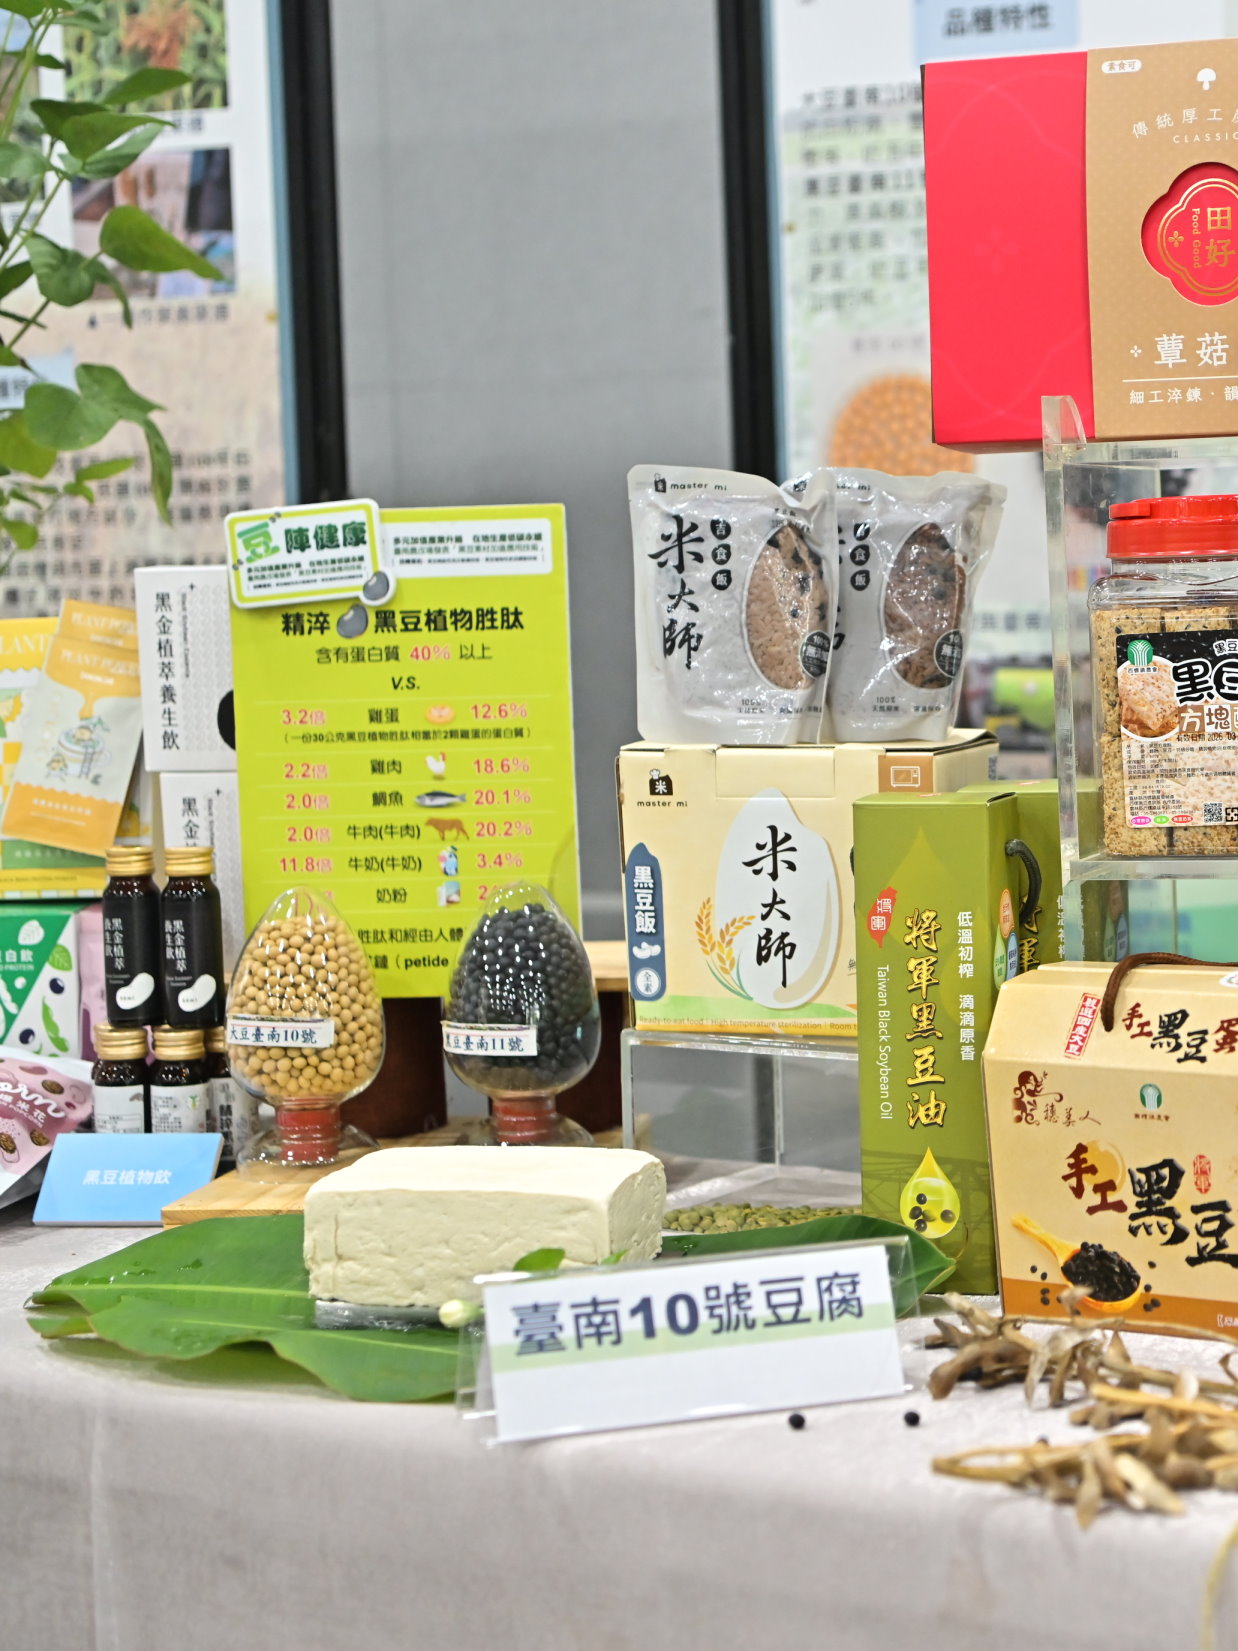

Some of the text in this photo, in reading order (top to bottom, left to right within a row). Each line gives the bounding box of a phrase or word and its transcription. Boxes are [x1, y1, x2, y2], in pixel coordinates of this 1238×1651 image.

[1191, 208, 1202, 269] Food Good
[1206, 206, 1236, 268] 田好
[648, 514, 705, 670] 米大師
[374, 606, 525, 634] 黑豆植物胜肽
[155, 592, 179, 751] 黑金植萃養生飲
[315, 643, 493, 664] 含有蛋白質 40% 以上
[470, 703, 528, 720] 12.6%
[473, 757, 530, 774] 18.6%
[474, 788, 531, 805] 20.1%
[182, 797, 200, 848] 黑金
[475, 820, 532, 837] 20.2%
[477, 851, 522, 869] 3.4%
[376, 887, 408, 904] 奶粉
[634, 866, 656, 934] 黑豆飯
[742, 824, 797, 988] 米大師
[173, 919, 187, 973] 黑金植萃
[957, 911, 975, 1062] 低溫初榨 滴滴原香
[230, 1024, 317, 1044] 大豆臺南10號
[711, 1019, 729, 1028] High
[730, 1020, 776, 1029] temperature
[877, 965, 893, 1120] Taiwan Black Soybean Oil
[903, 908, 946, 1129] 將軍黑豆油
[83, 1169, 172, 1185] 黑豆植物飲
[511, 1271, 864, 1356] 臺南10號豆腐
